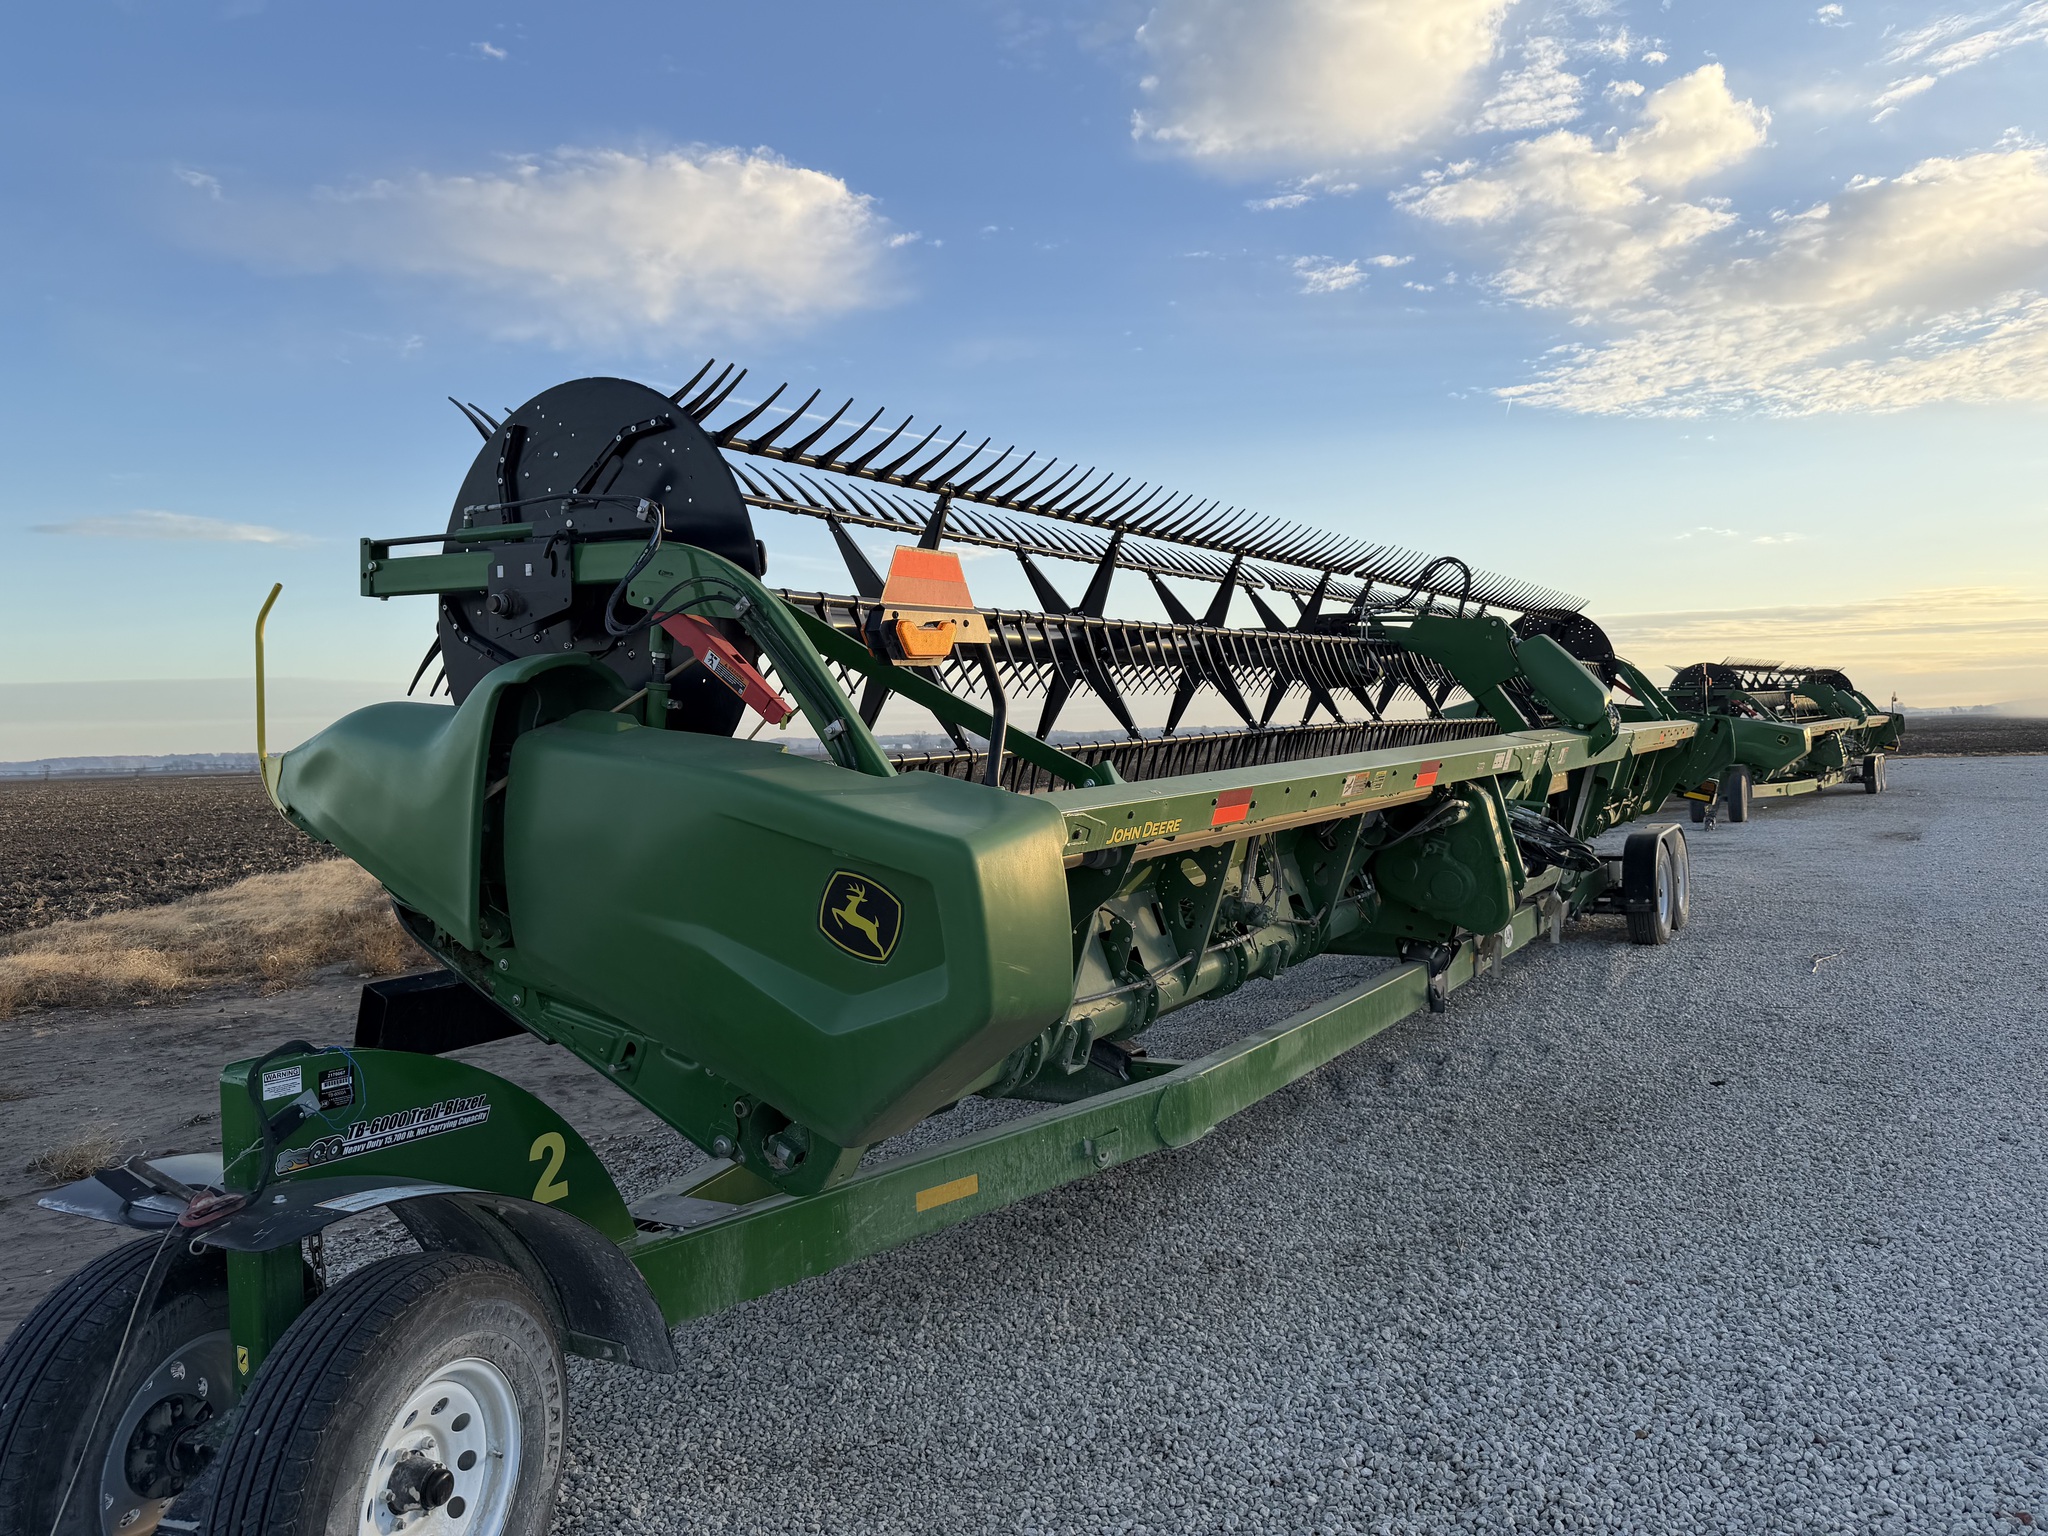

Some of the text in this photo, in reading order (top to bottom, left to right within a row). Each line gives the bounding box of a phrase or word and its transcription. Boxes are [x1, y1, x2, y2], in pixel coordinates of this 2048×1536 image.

[1106, 819, 1182, 844] JOHN DEERE
[265, 1068, 298, 1081] WARNING
[342, 1143, 366, 1155] Heavy
[366, 1139, 384, 1149] Duty
[416, 1126, 428, 1137] Net
[429, 1119, 457, 1133] Carrying
[458, 1112, 487, 1125] Capacity
[348, 1095, 486, 1140] TB-6000 Trail-Blazer
[528, 1131, 569, 1203] 2
